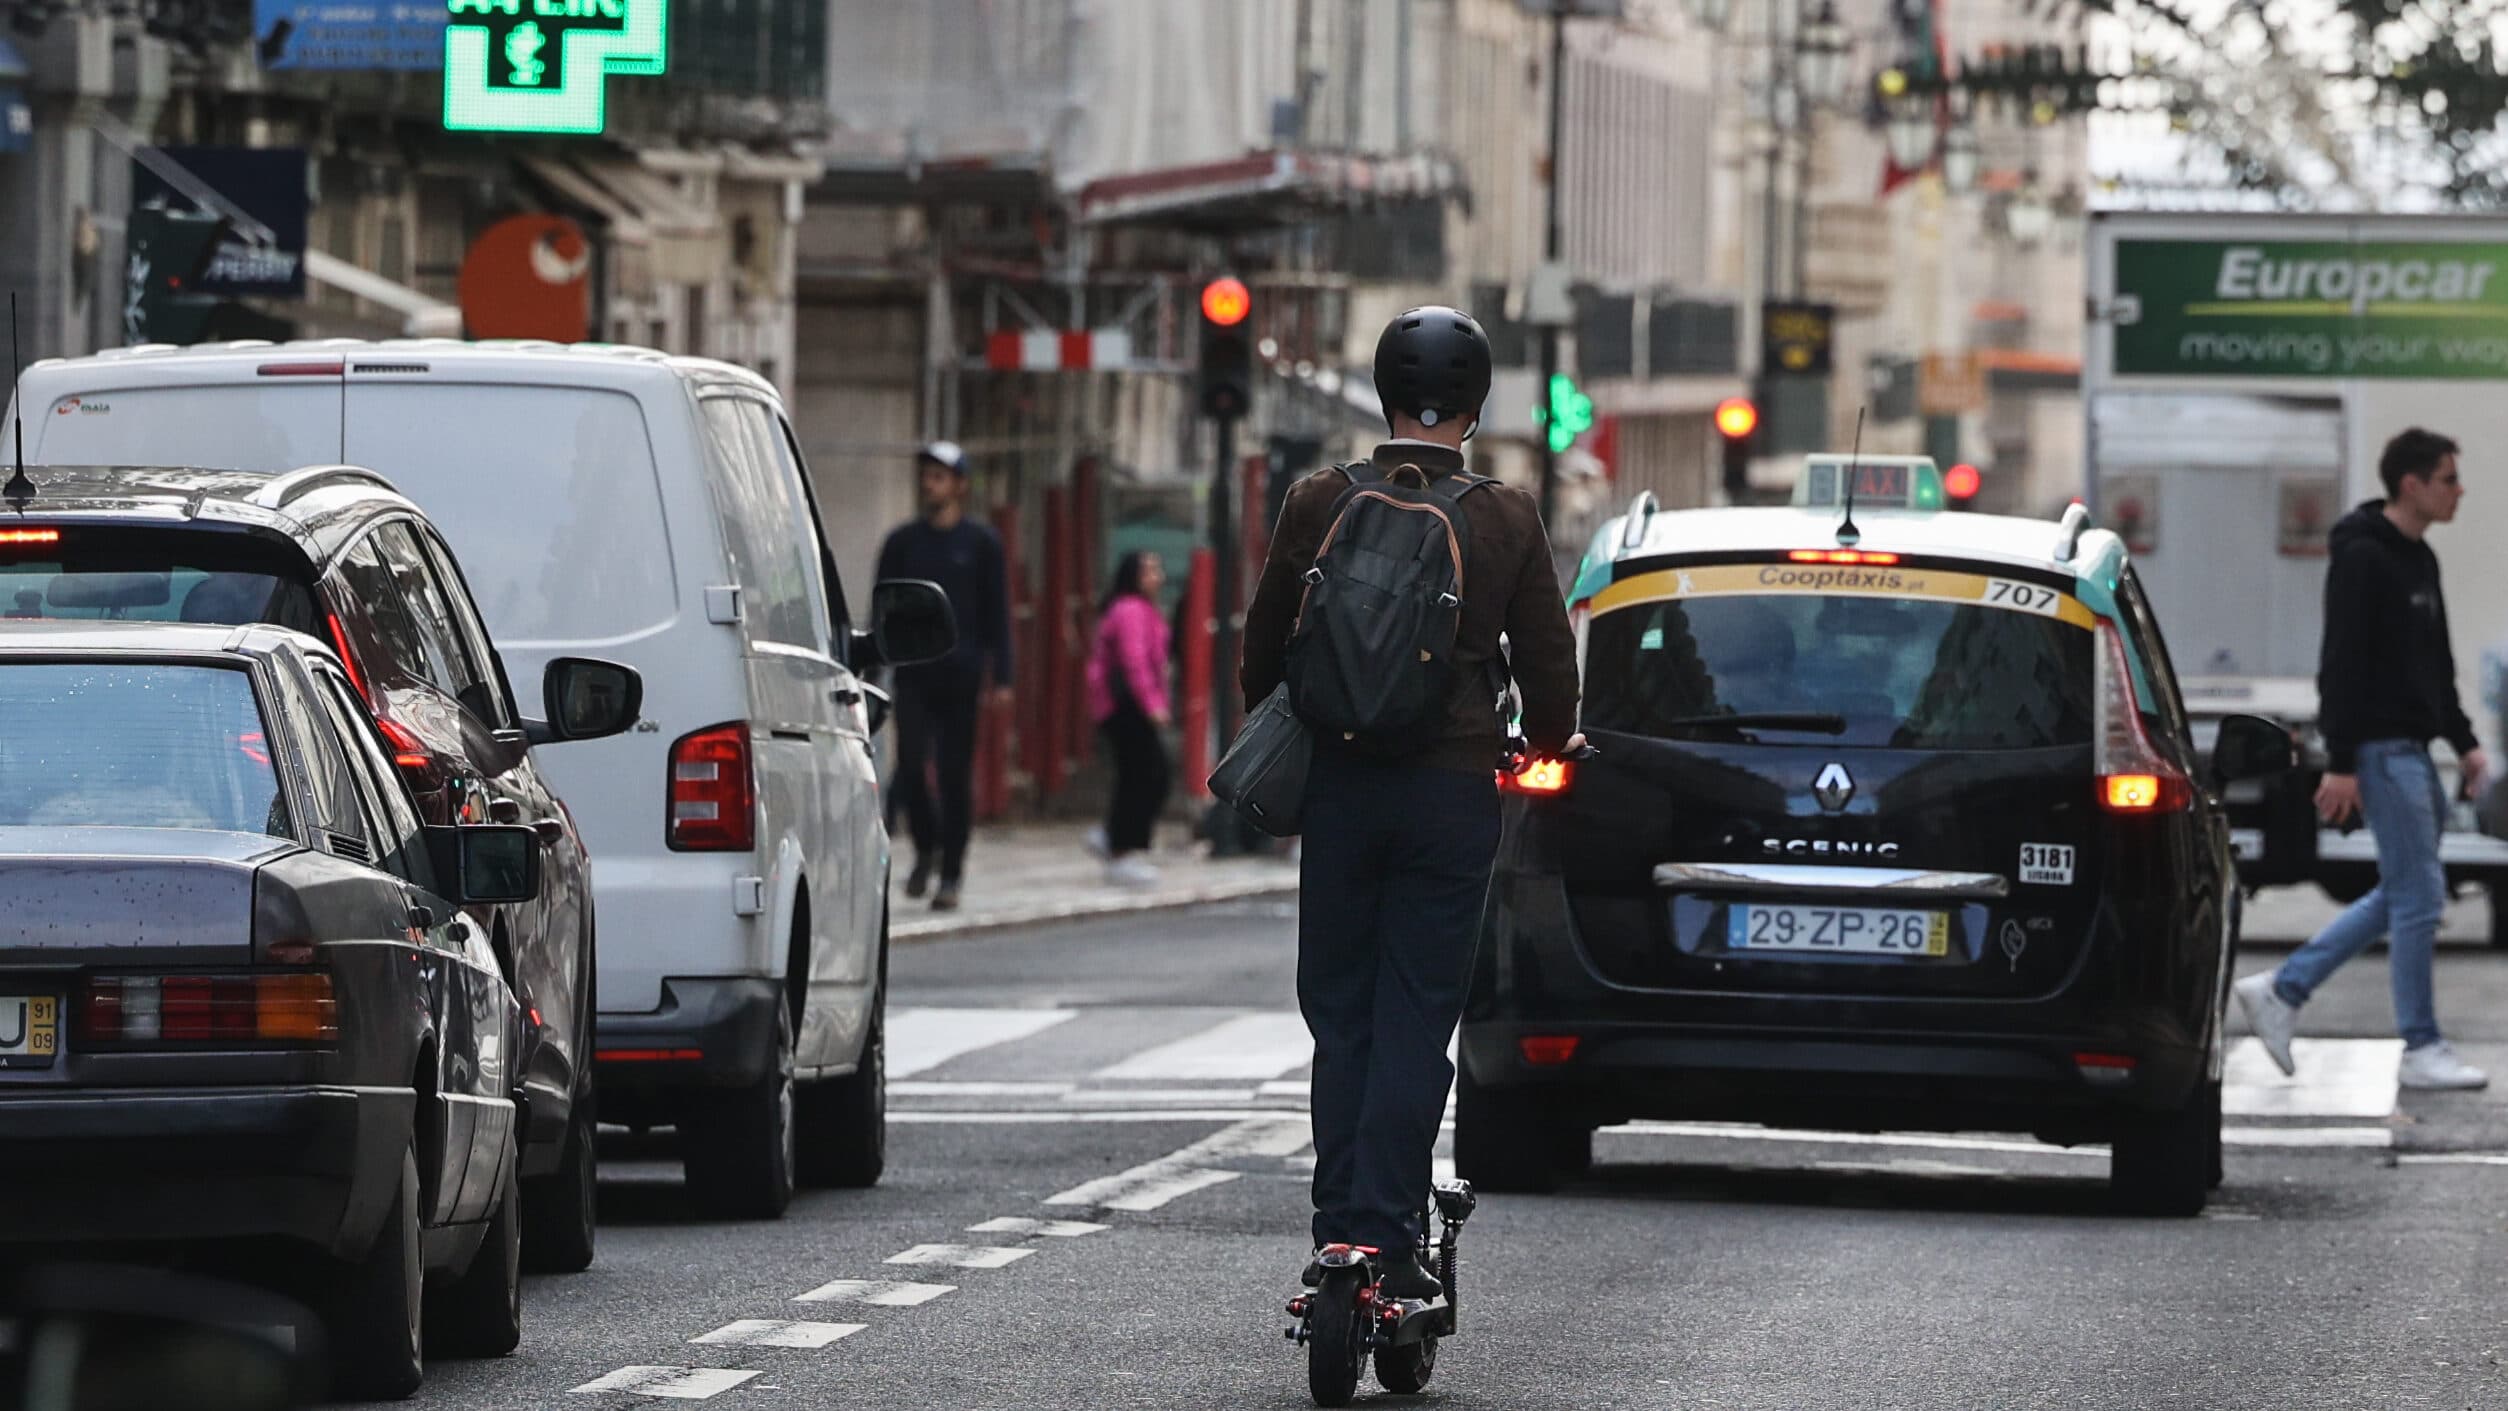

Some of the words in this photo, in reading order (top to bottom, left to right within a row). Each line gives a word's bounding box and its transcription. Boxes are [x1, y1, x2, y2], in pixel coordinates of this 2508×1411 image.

[2216, 247, 2497, 317] Europcar
[2179, 334, 2333, 371] moving
[2337, 336, 2430, 371] your
[2438, 338, 2508, 370] wa
[1992, 582, 2055, 609] 707
[1763, 838, 1899, 858] SCENIC
[2022, 846, 2072, 869] 3181
[34, 1003, 52, 1019] 91
[33, 1033, 53, 1049] 09
